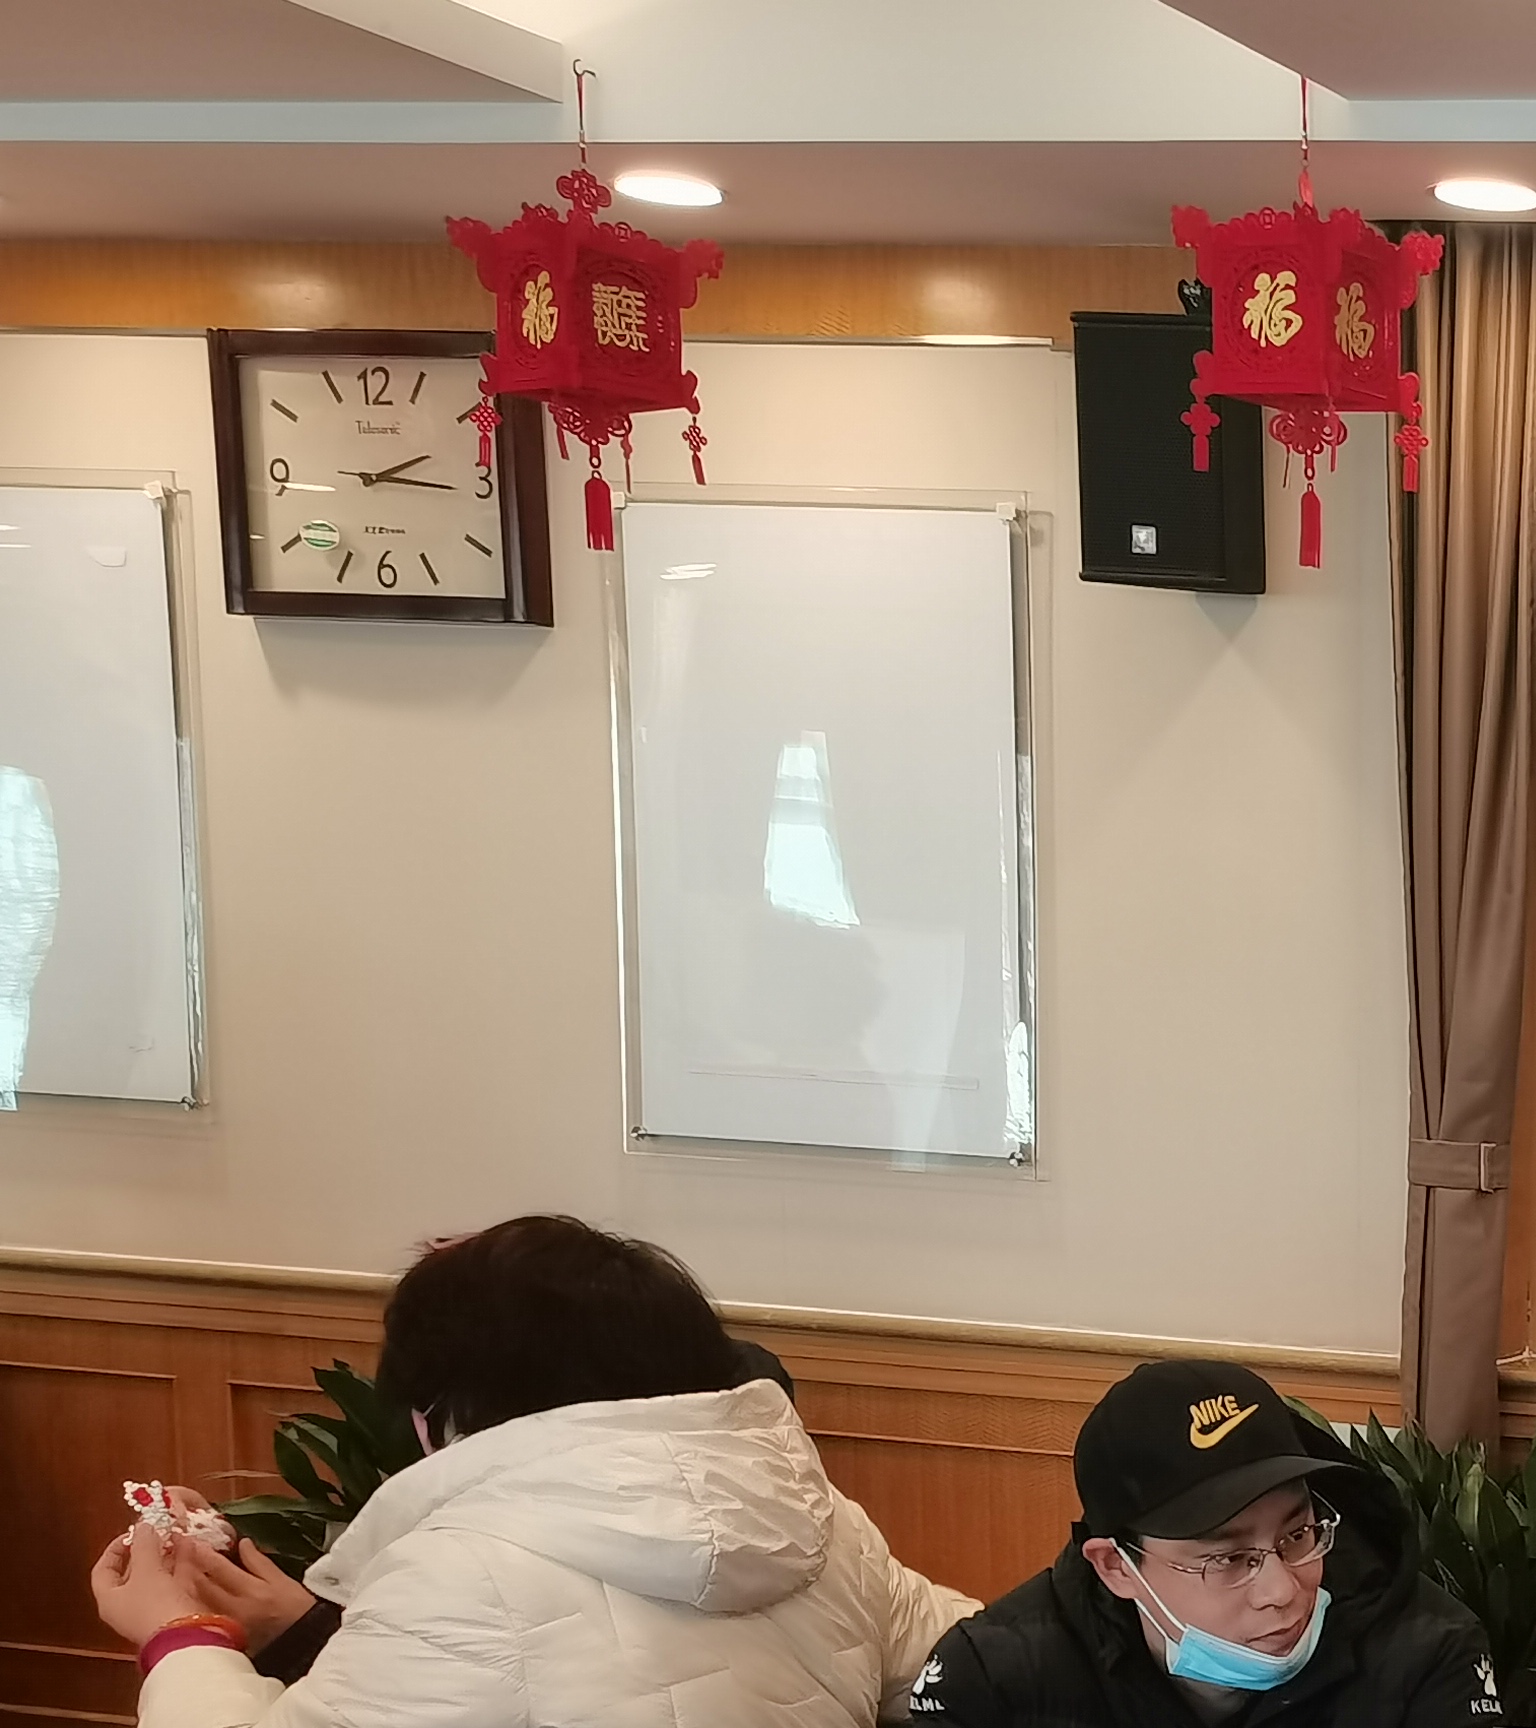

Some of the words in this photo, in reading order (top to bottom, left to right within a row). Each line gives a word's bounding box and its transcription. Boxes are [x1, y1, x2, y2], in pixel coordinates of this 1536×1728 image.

[1243, 271, 1303, 347] 福
[1333, 281, 1376, 361] 福
[356, 366, 394, 406] 12
[269, 457, 291, 496] 9
[474, 462, 495, 500] 3
[377, 550, 398, 589] 6
[1189, 1394, 1241, 1429] NIKE
